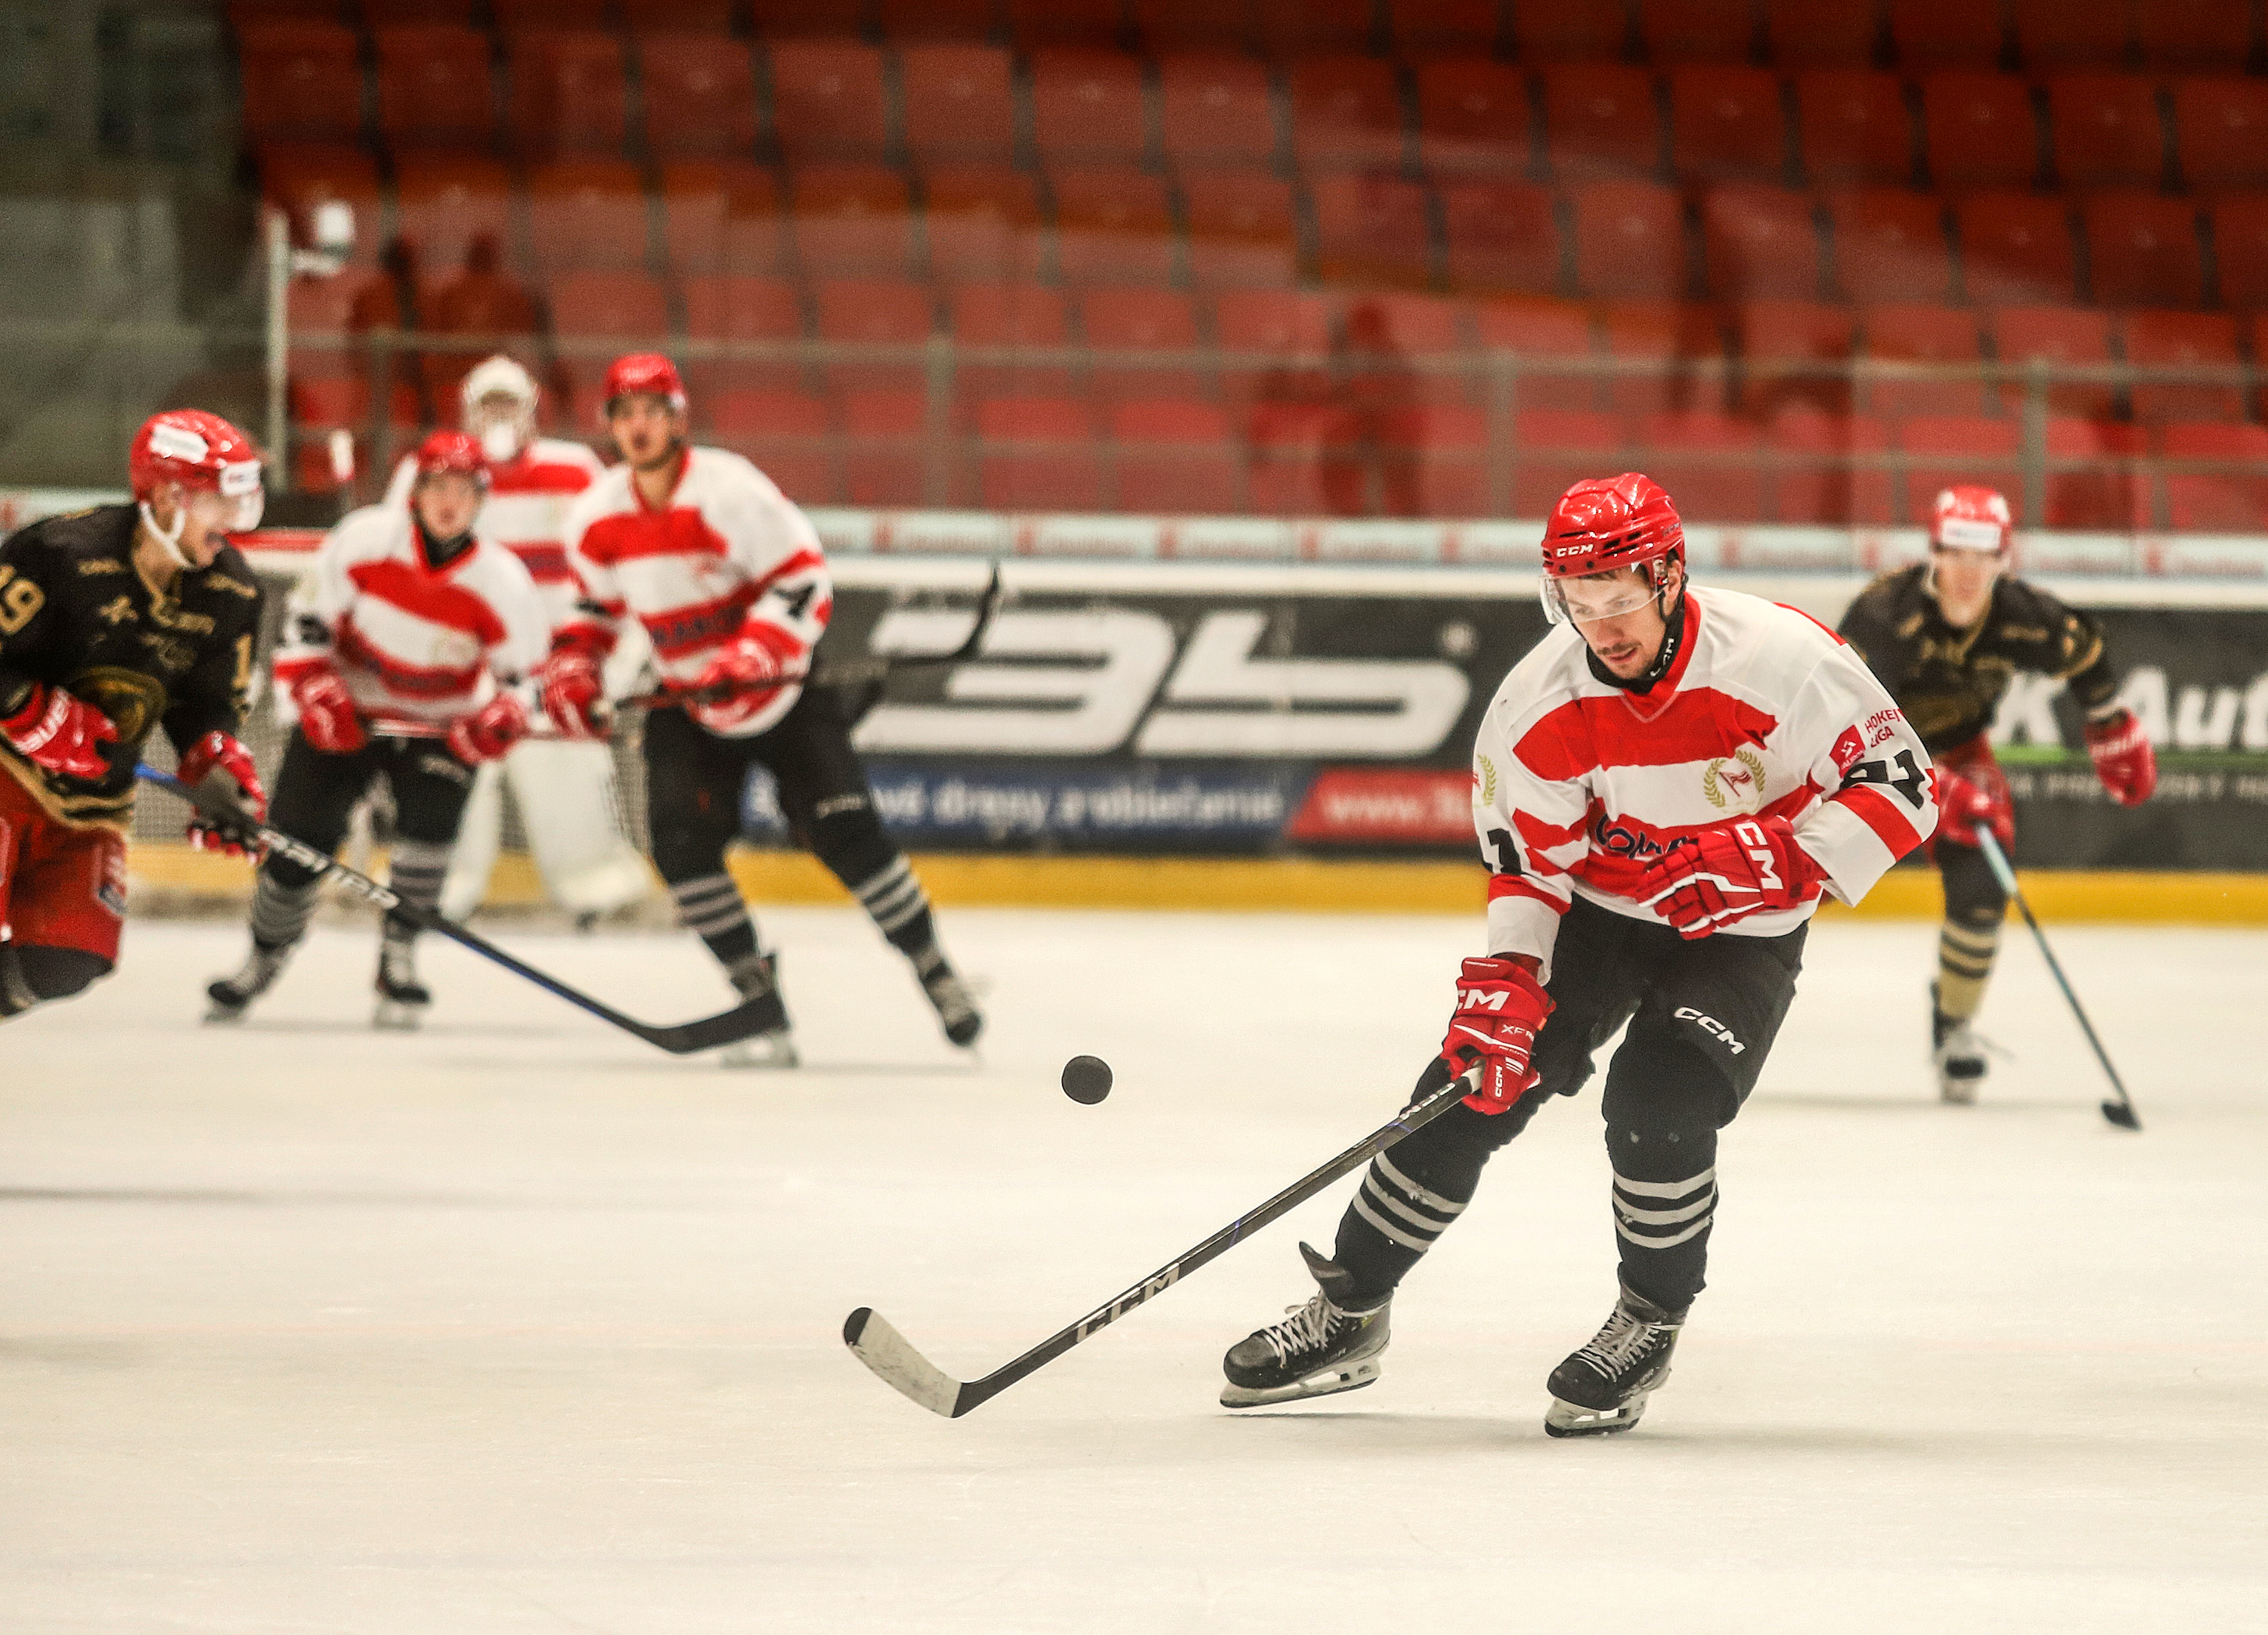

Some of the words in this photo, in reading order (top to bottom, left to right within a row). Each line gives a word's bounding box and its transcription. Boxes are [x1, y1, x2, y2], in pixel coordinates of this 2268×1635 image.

[1557, 543, 1594, 558] CCM
[1870, 726, 1895, 748] LIGA
[1734, 821, 1784, 890] CM
[1673, 1006, 1746, 1055] CCM
[1495, 1064, 1504, 1098] CCM
[1076, 1262, 1181, 1343] CCM
